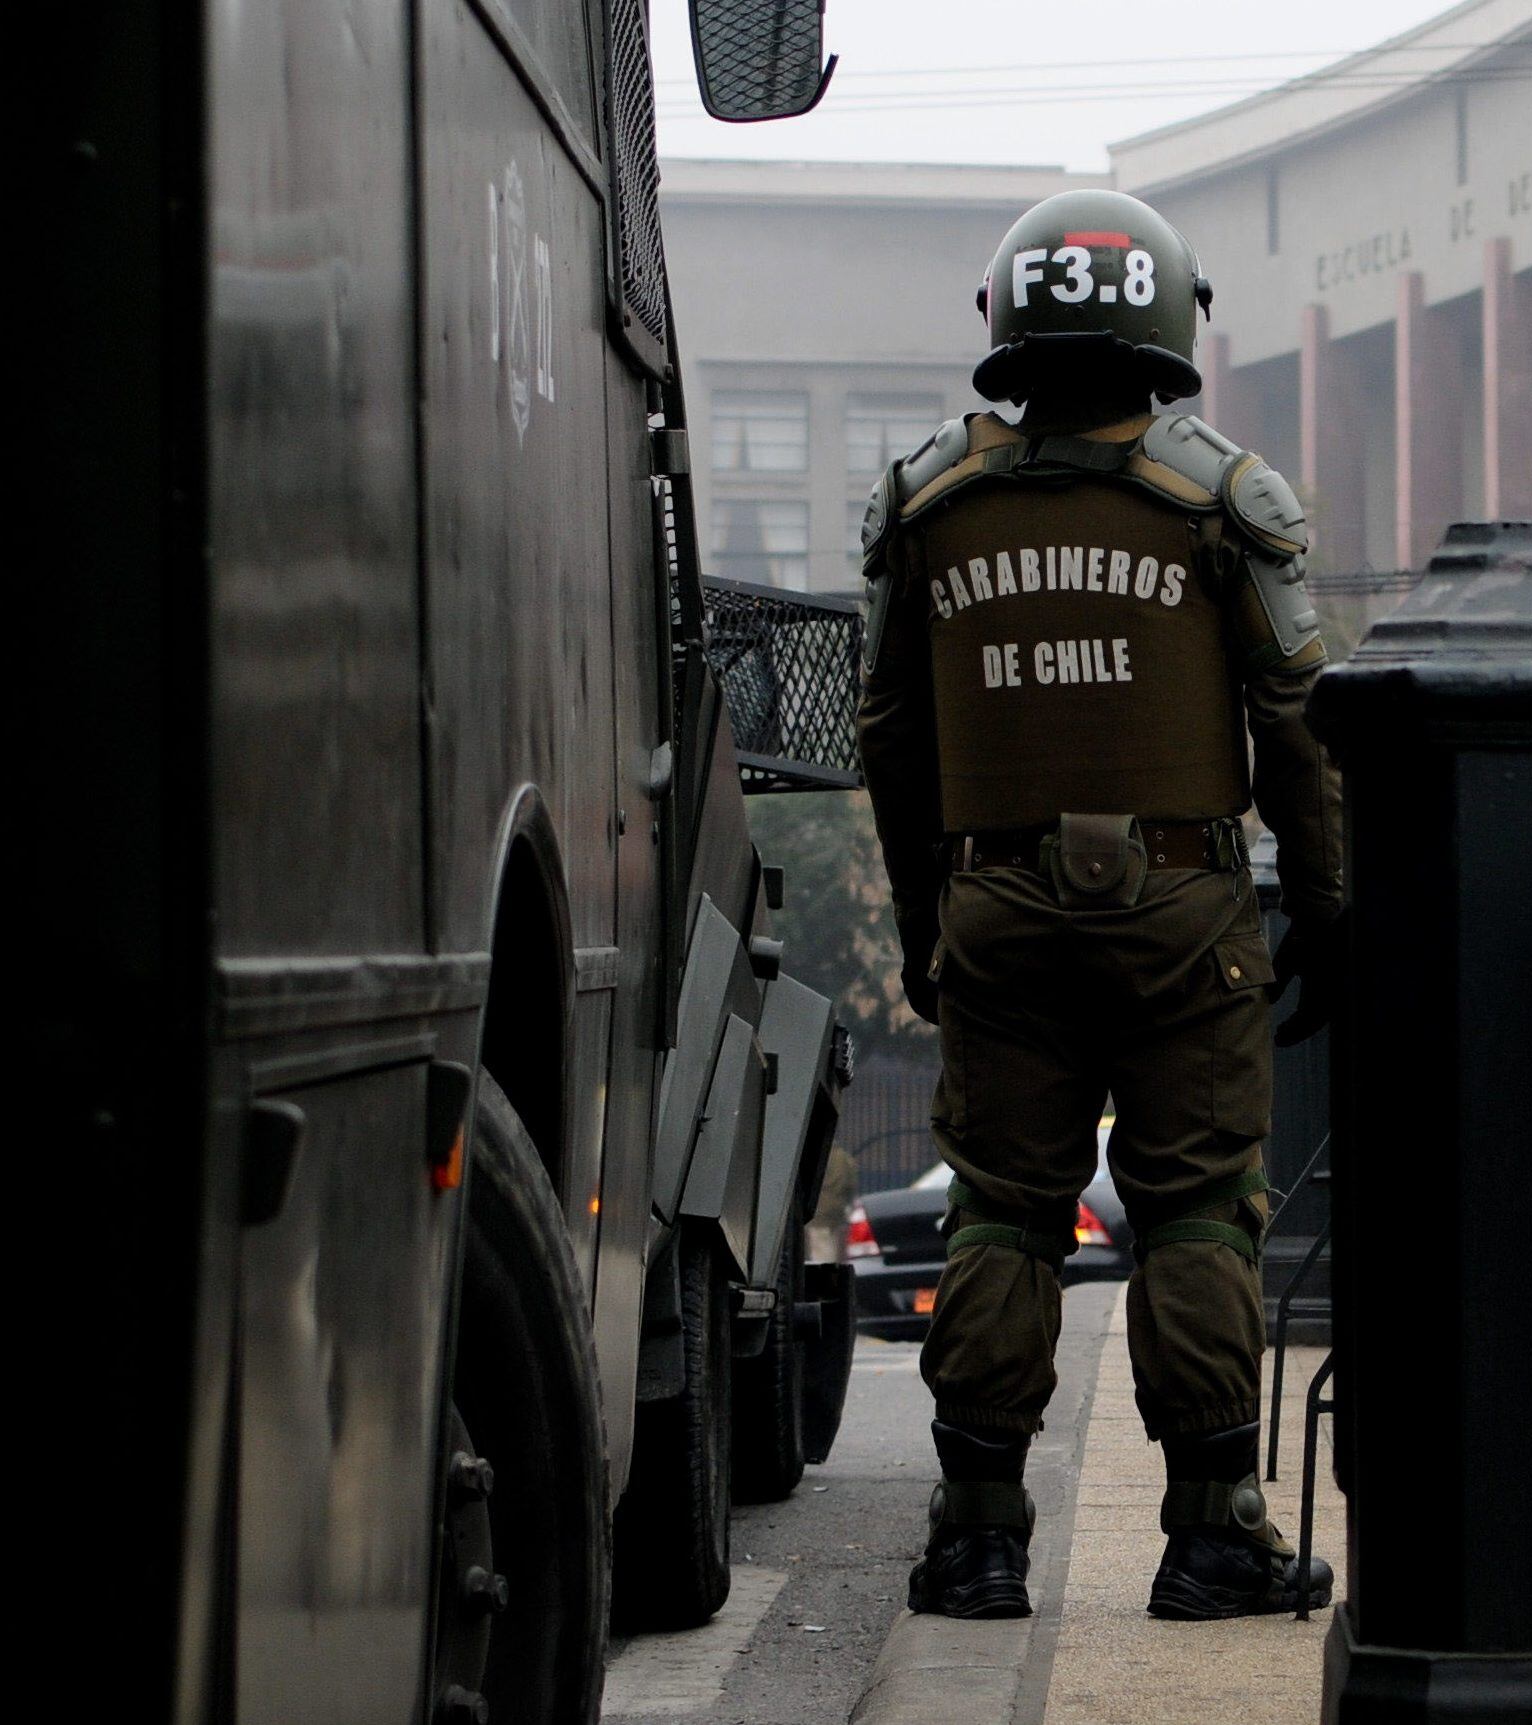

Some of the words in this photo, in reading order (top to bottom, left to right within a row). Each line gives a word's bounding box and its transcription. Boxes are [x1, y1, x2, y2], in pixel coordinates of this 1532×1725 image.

[1012, 246, 1156, 308] F3.8
[1316, 226, 1412, 292] ESCUELA
[1449, 198, 1475, 243] DE
[930, 546, 1187, 619] CARABINEROS
[983, 644, 1021, 688] DE
[1034, 639, 1132, 685] CHILE
